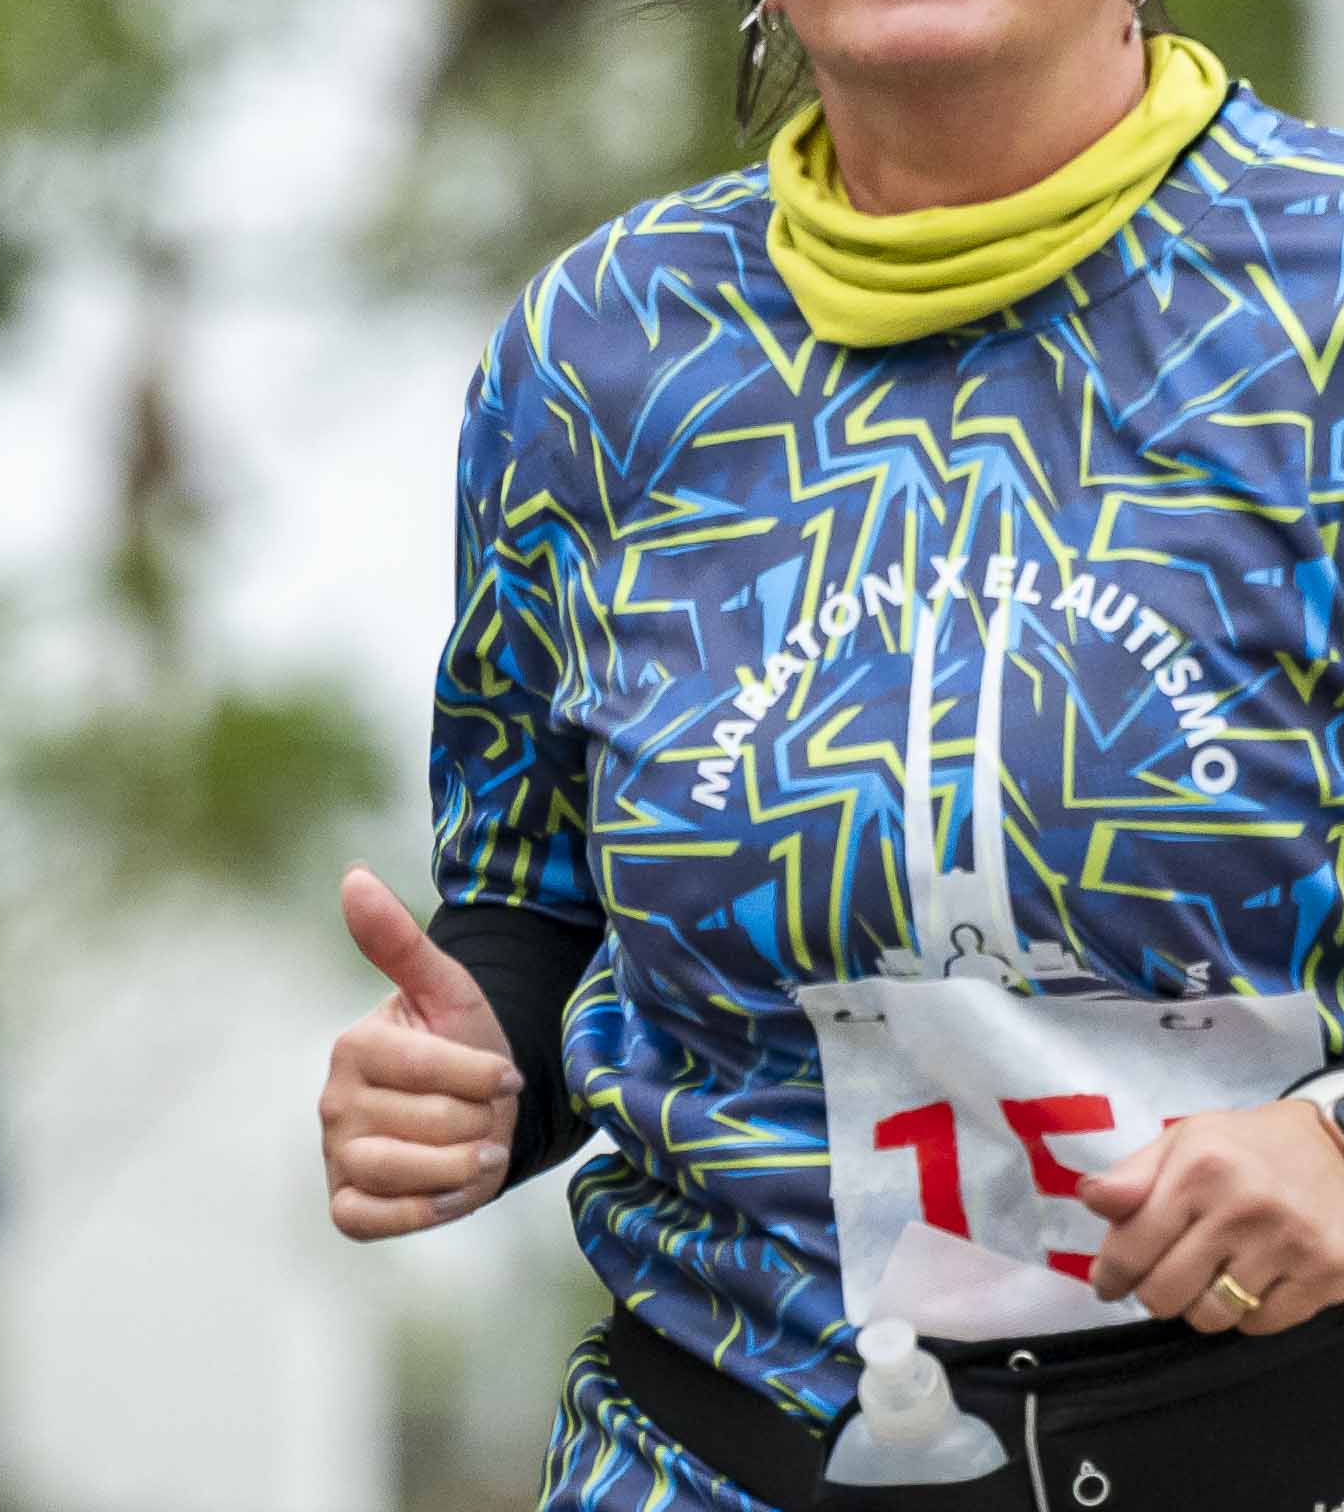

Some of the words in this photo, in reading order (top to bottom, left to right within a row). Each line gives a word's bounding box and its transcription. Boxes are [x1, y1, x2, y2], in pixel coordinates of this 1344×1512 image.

[692, 562, 907, 811] MARATÓN
[926, 554, 970, 600] X
[982, 553, 1042, 606] EL
[1050, 573, 1239, 795] AUTISMO
